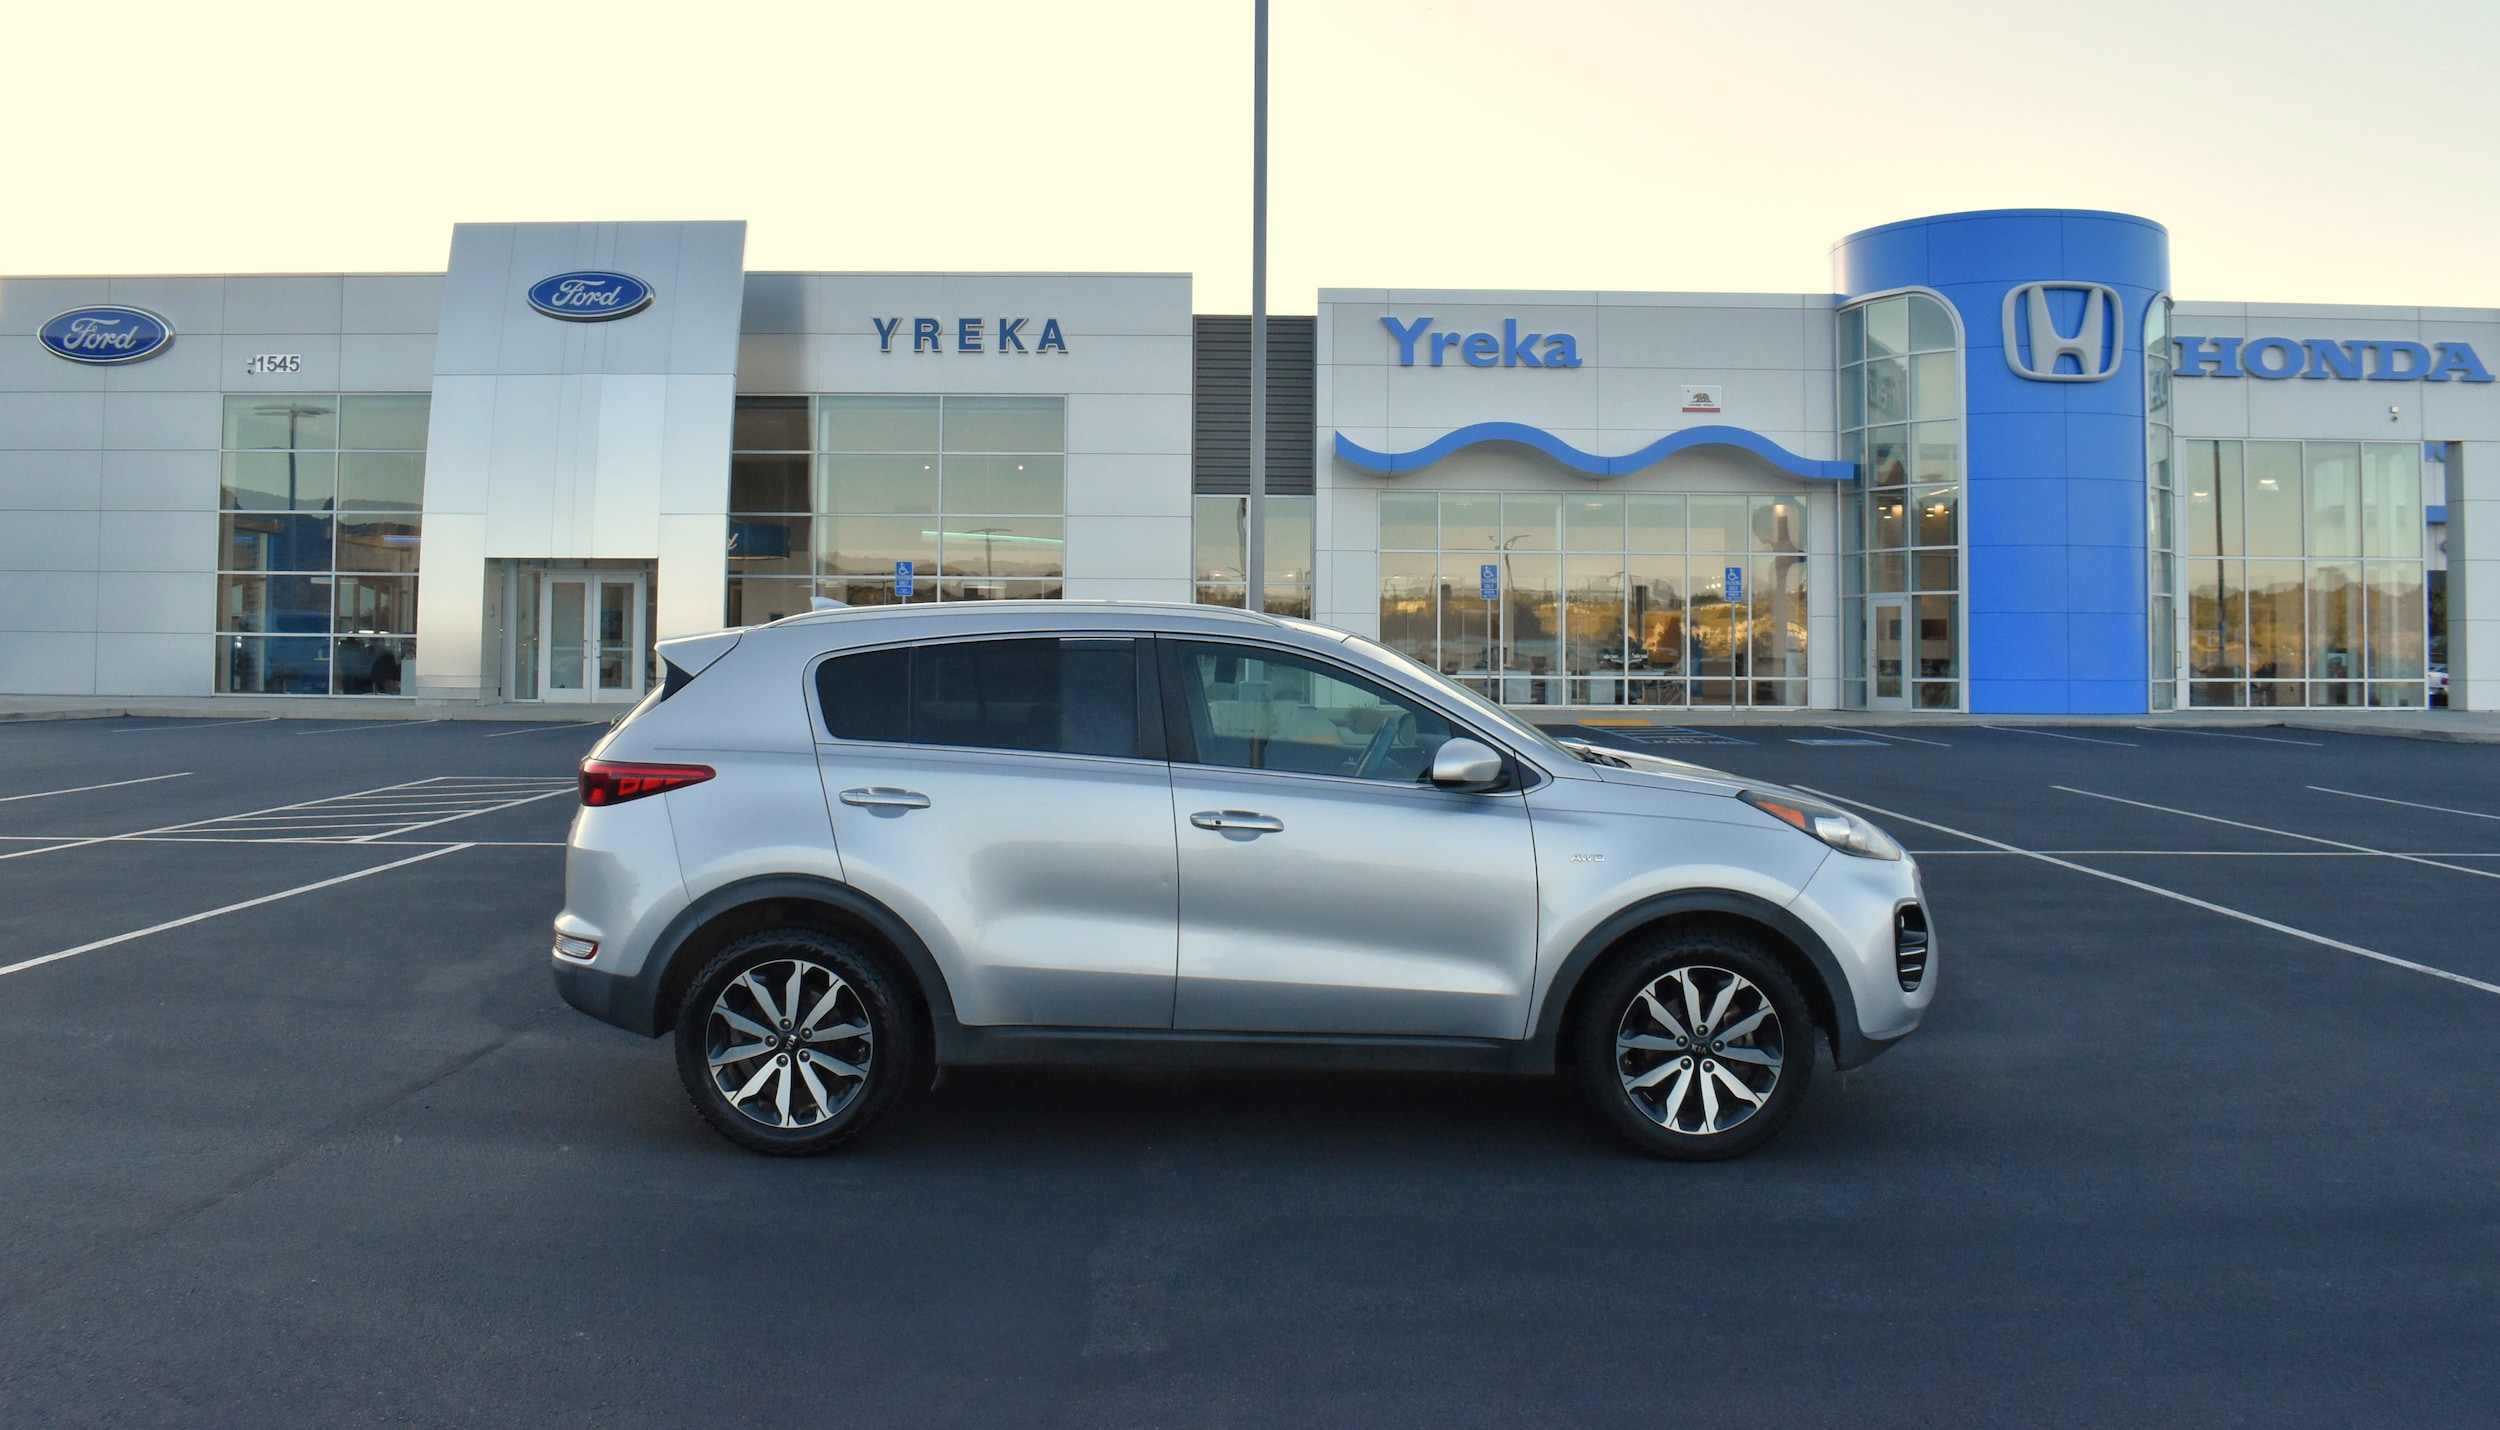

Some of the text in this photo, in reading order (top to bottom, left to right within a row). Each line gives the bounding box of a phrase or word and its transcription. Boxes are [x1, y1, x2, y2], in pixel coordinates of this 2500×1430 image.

[551, 279, 623, 306] Ford
[63, 317, 140, 349] Ford
[872, 317, 1069, 353] YREKA
[1380, 316, 1582, 368] Yreka
[256, 355, 300, 373] 1545
[2172, 335, 2496, 382] HONDA
[1570, 854, 1605, 862] AWD
[784, 1034, 797, 1050] KIA
[1691, 1043, 1707, 1055] KIA
